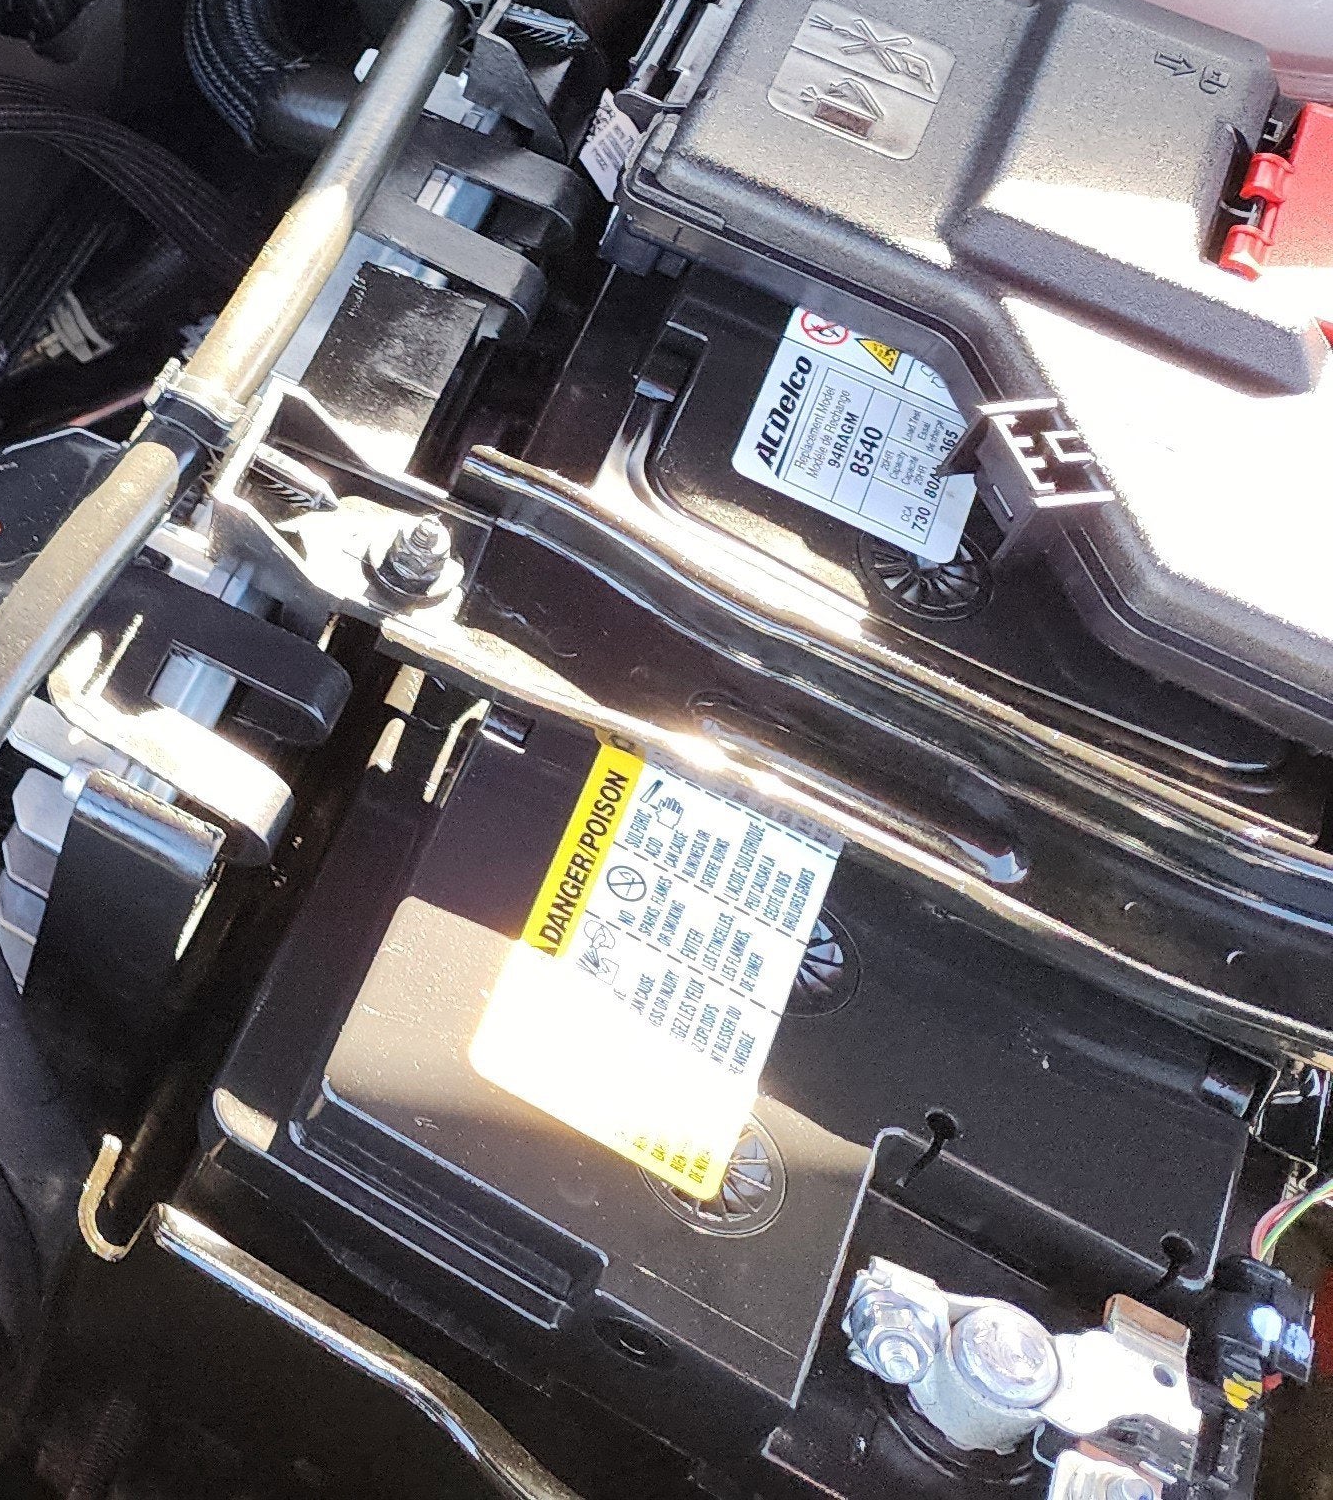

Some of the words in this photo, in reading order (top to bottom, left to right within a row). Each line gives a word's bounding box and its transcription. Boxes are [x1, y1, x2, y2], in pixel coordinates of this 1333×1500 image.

[755, 355, 813, 471] ACDelco
[794, 412, 825, 470] Replacement
[816, 385, 835, 415] Model
[827, 411, 860, 469] 94RAGM
[849, 426, 883, 477] 8540
[910, 506, 931, 533] 730
[624, 808, 653, 849] SULFURIC
[669, 829, 689, 854] CAUSE
[733, 820, 766, 873] SULFURIQUE
[538, 767, 630, 947] DANGER/POISON
[643, 836, 664, 859] ACID
[663, 850, 680, 869] CAN
[681, 839, 707, 879] BLINDNESS
[650, 875, 673, 907] FLAMES
[617, 909, 636, 928] NO
[661, 900, 686, 936] SMOKING
[658, 968, 680, 1000] INJURY
[743, 951, 765, 982] FUMER
[634, 973, 656, 1001] CAUSE
[683, 977, 706, 1003] YEUX
[677, 1000, 697, 1021] LES
[693, 1003, 720, 1045] EXPLOSIFS
[713, 1017, 738, 1053] BLESSER
[732, 1030, 755, 1067] AVEUGLE
